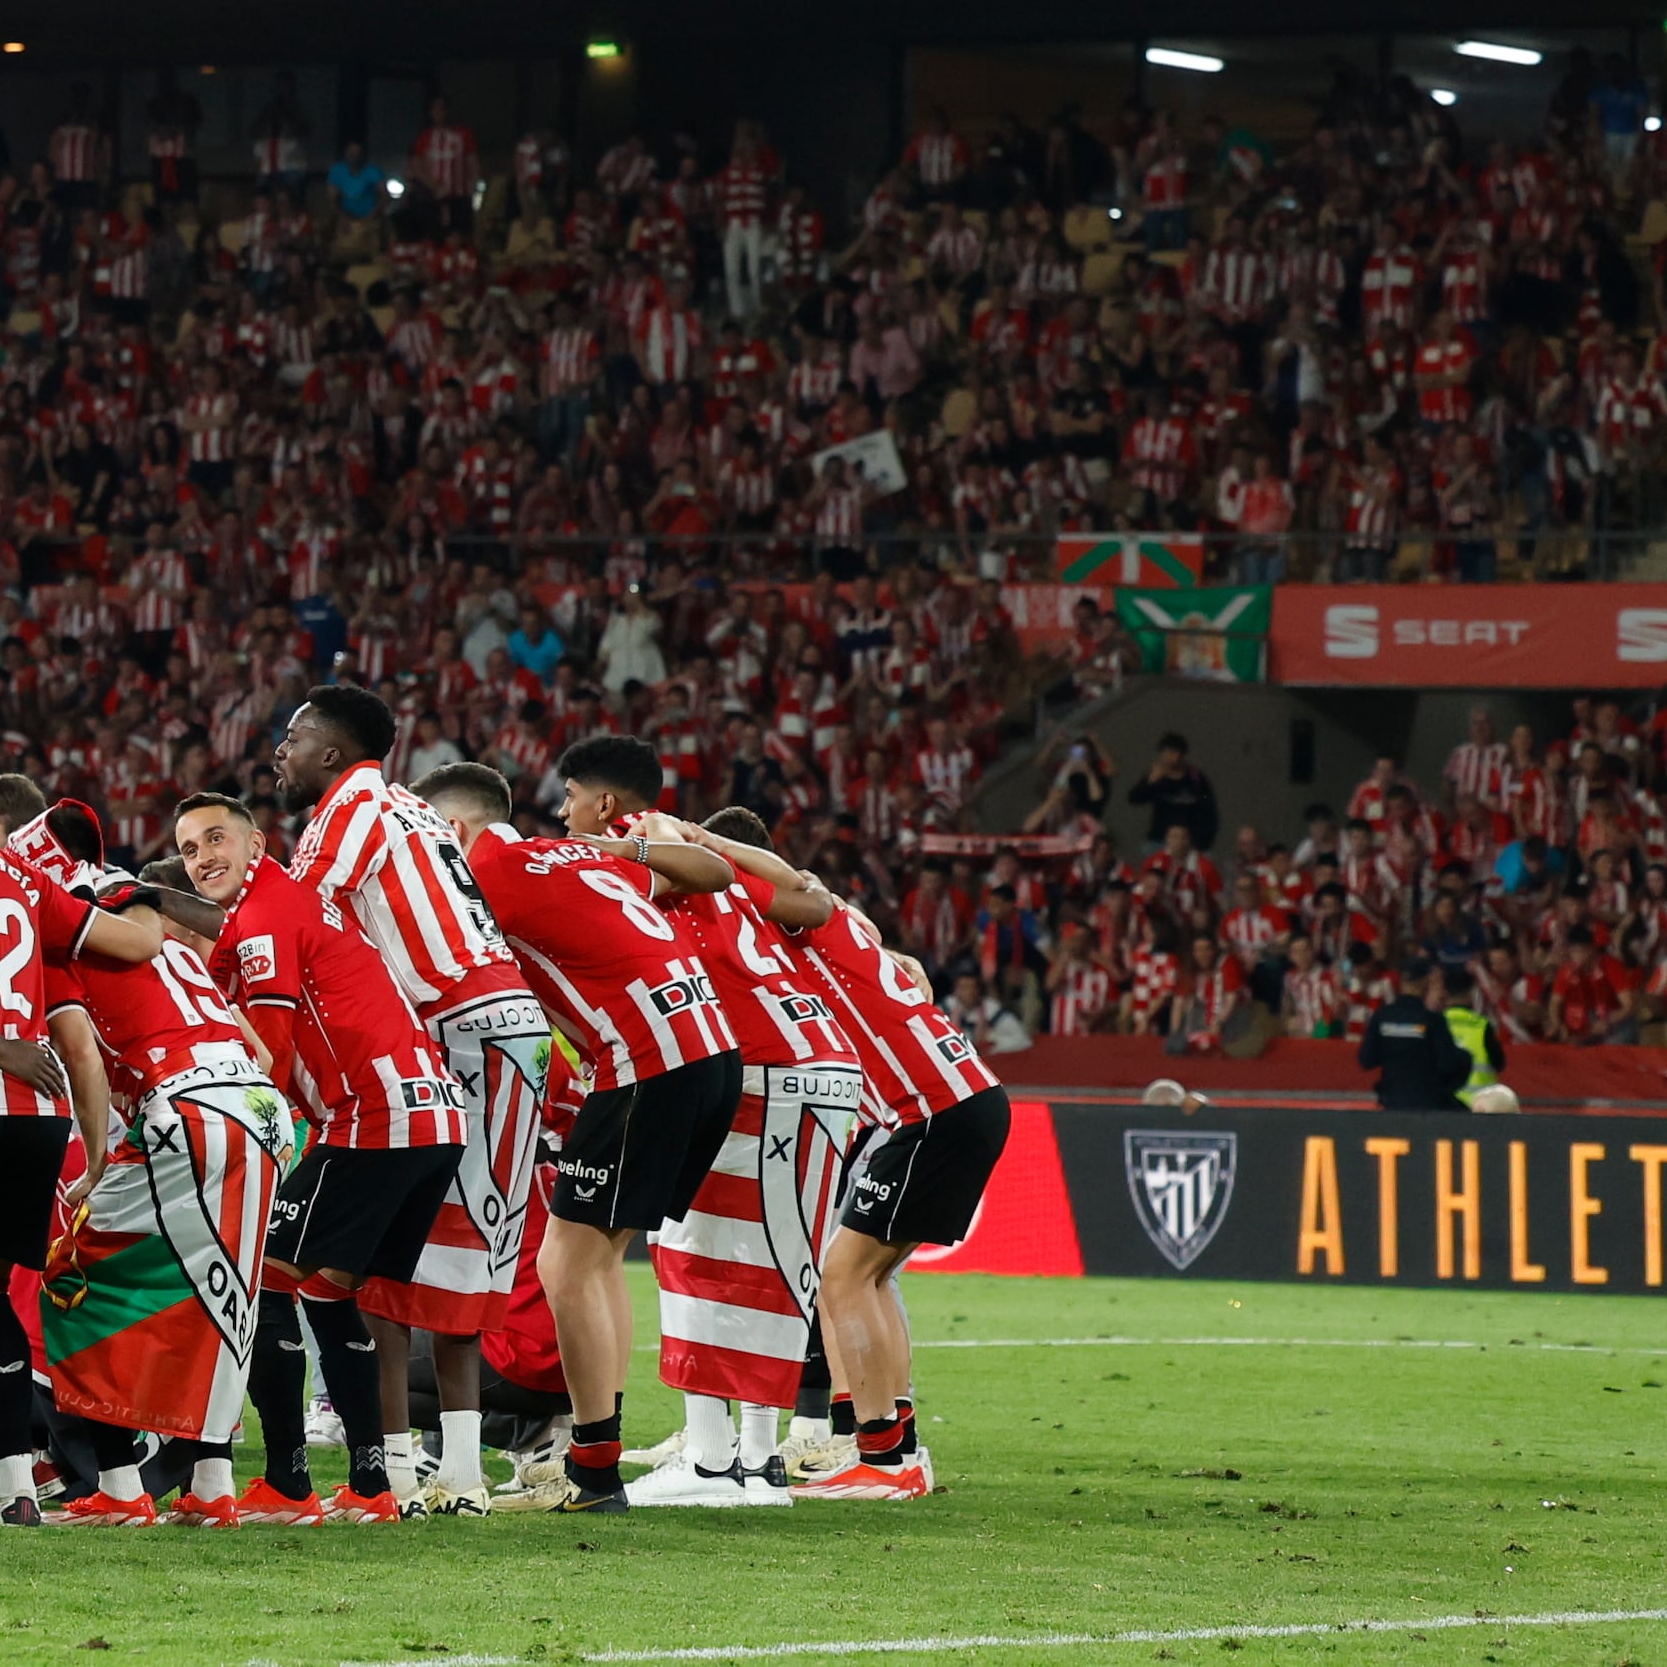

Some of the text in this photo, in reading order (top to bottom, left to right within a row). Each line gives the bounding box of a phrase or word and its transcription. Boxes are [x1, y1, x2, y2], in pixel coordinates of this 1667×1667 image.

[1392, 619, 1531, 646] SEAT
[579, 868, 676, 943] 8
[149, 939, 241, 1028] 19
